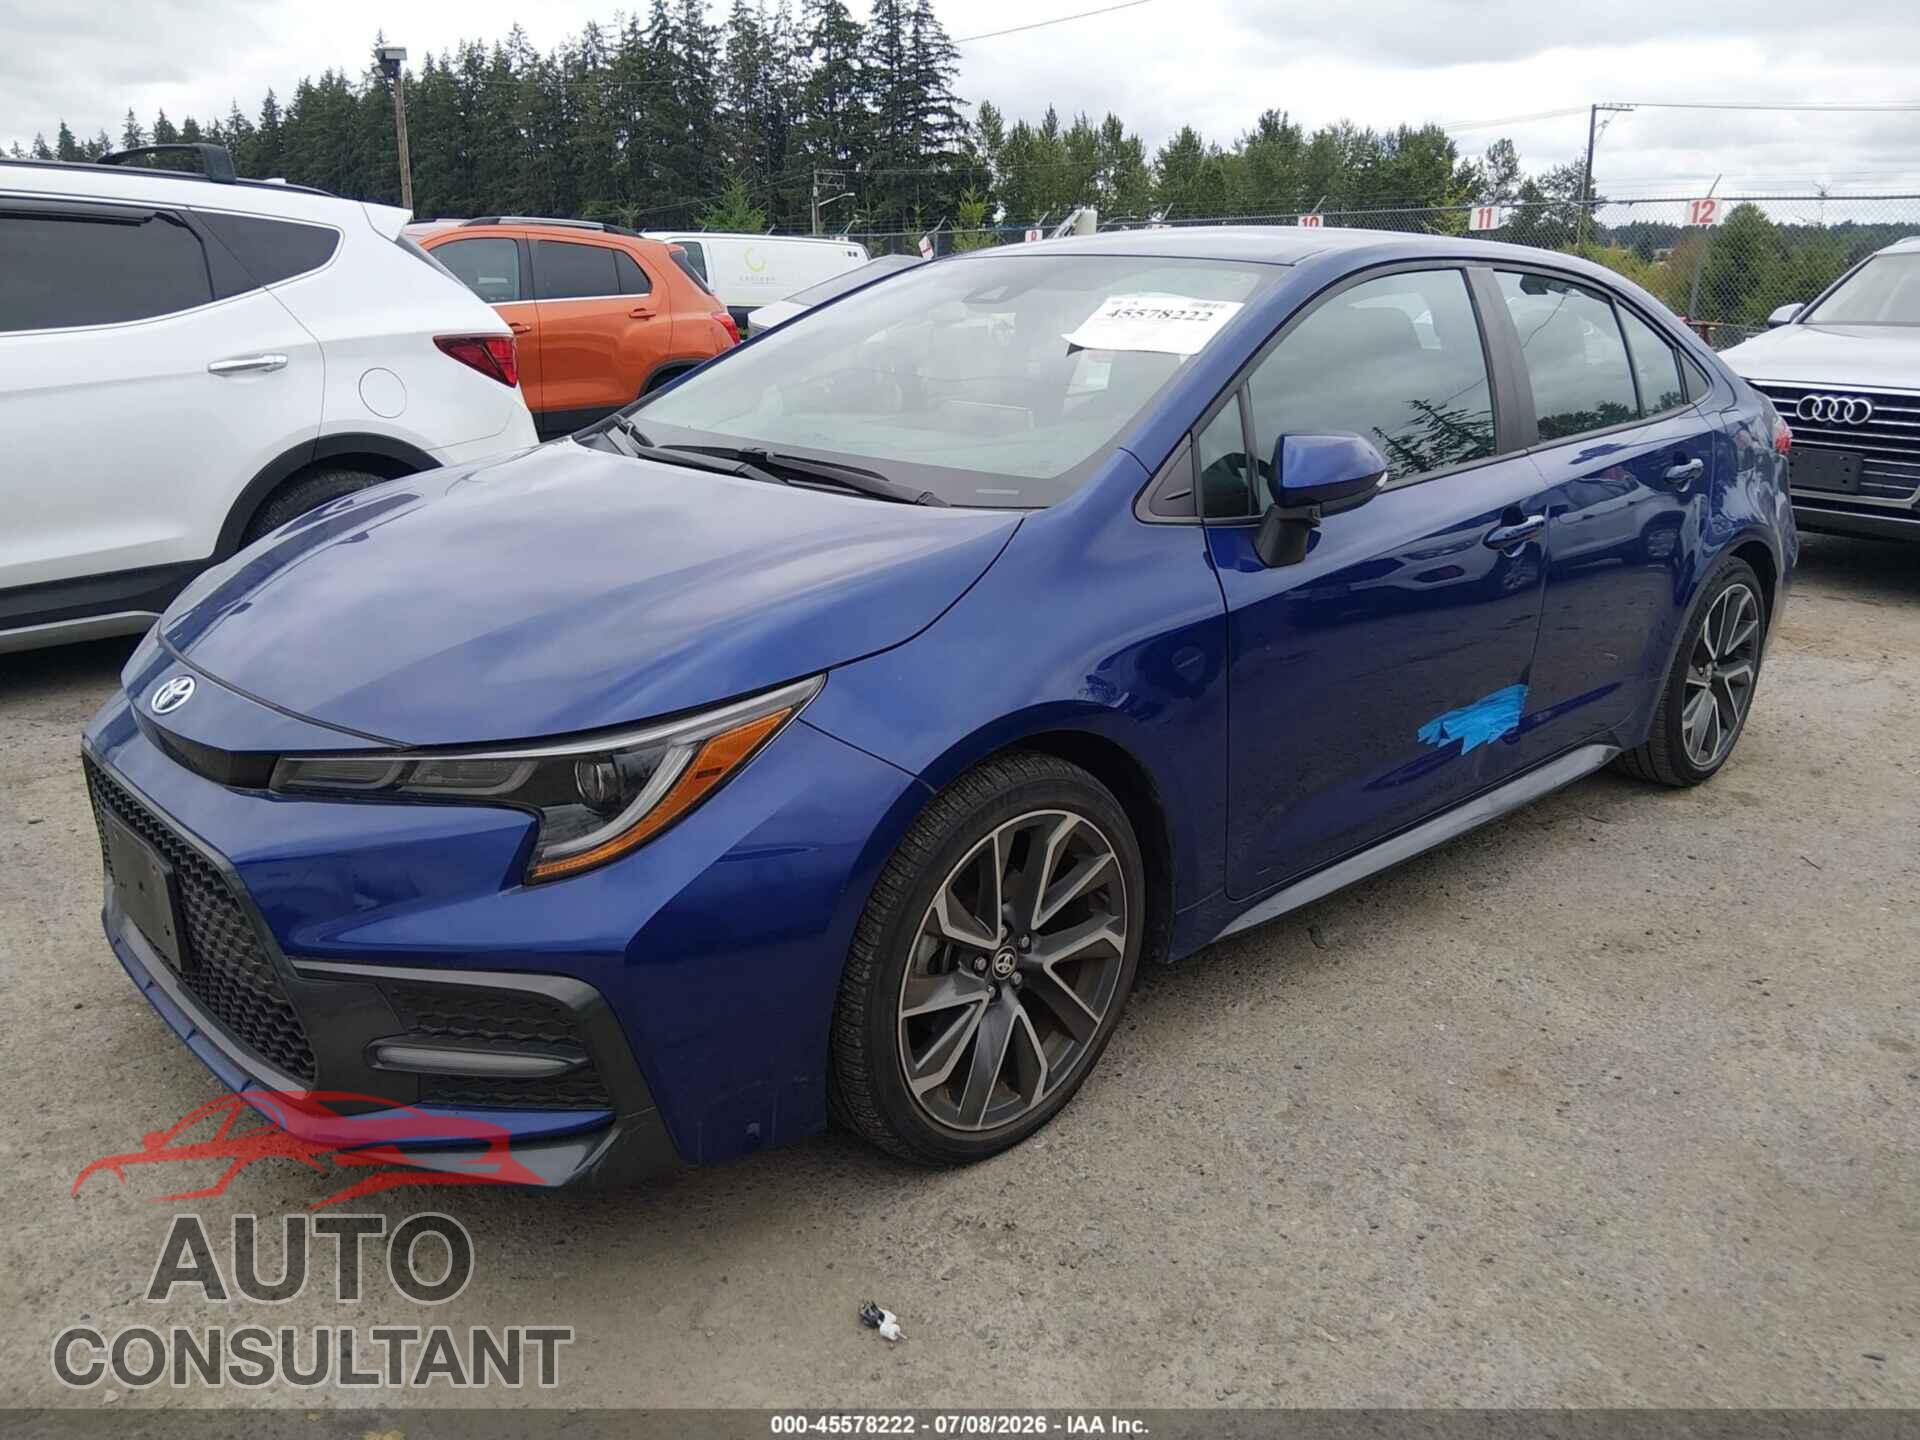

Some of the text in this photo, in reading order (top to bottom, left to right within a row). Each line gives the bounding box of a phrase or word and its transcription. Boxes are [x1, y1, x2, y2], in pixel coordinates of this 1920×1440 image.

[1478, 207, 1493, 229] 11
[1691, 200, 1716, 224] 12
[1106, 308, 1213, 322] 45578222
